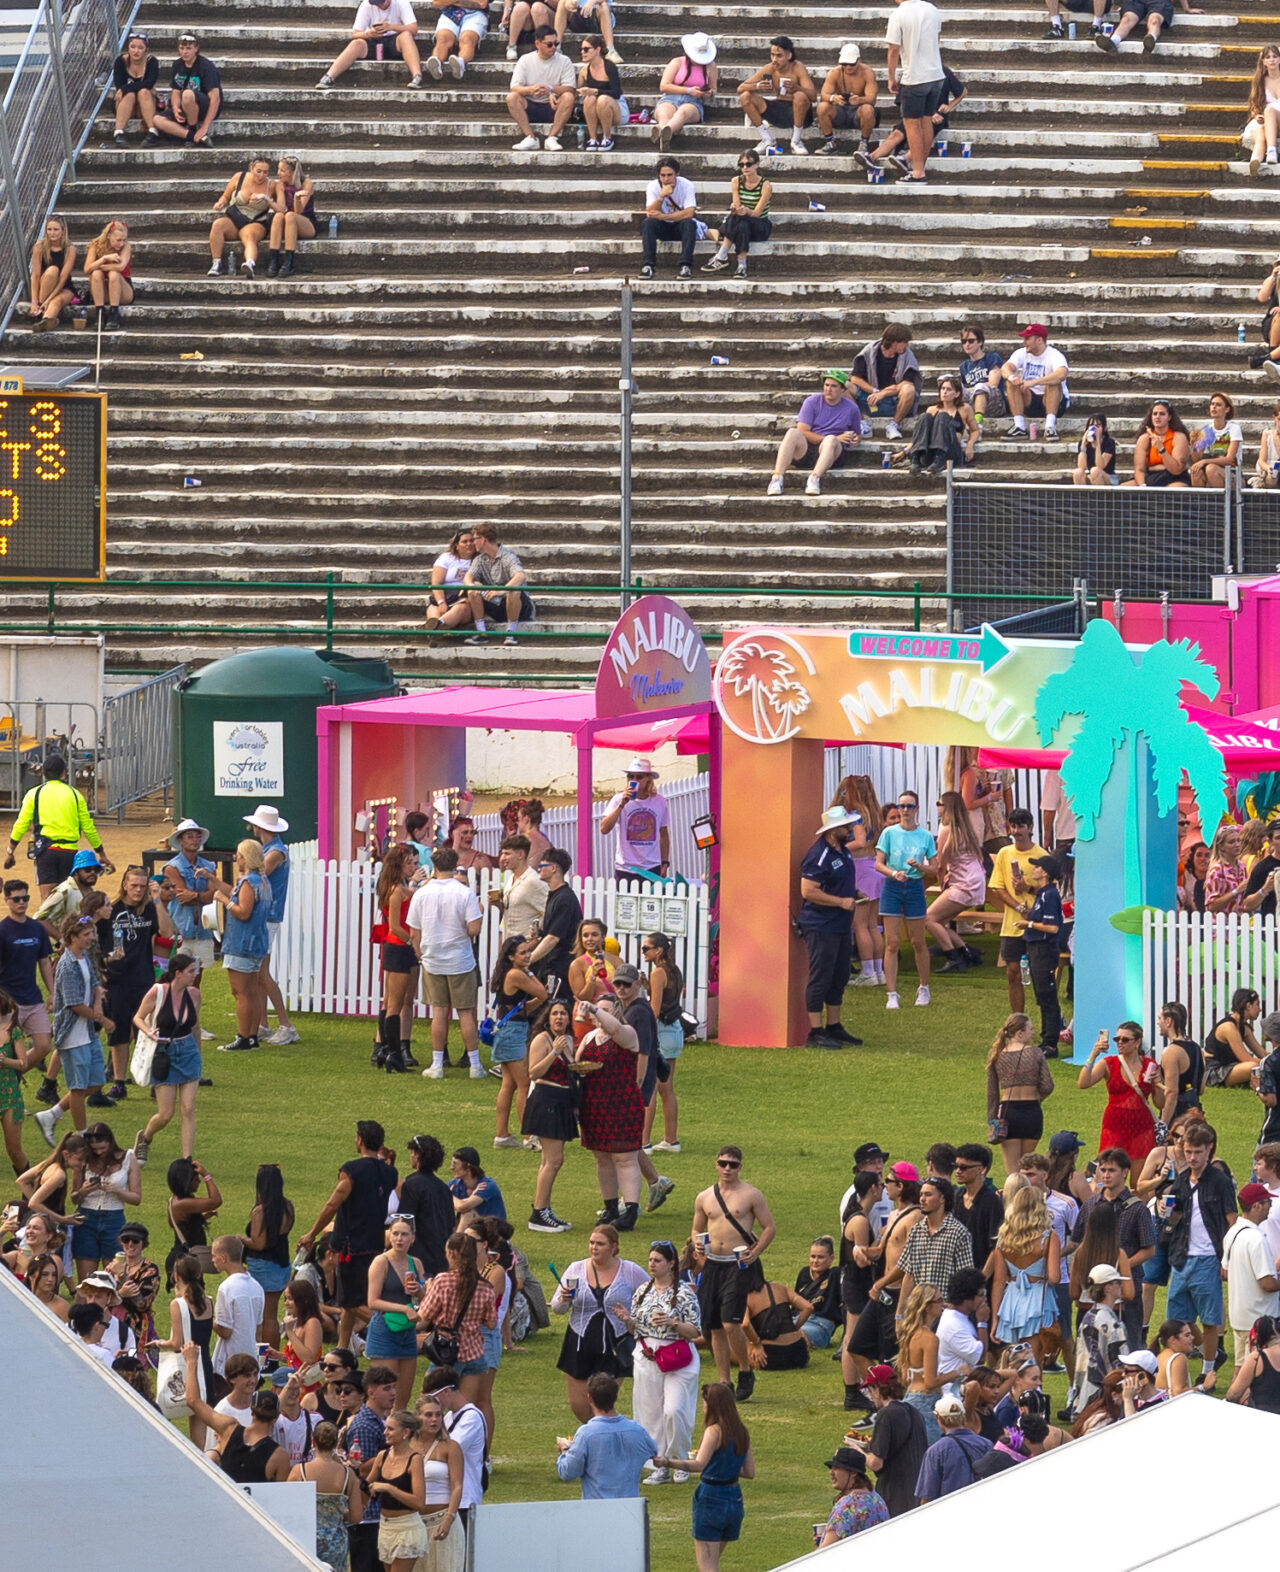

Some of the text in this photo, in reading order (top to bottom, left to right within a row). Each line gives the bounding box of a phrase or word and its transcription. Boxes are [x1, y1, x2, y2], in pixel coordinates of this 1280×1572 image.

[30, 402, 61, 439] 3
[609, 611, 702, 688] MALIBU
[860, 636, 980, 658] WELCOME TO
[628, 668, 685, 704] Makeover
[838, 667, 1028, 742] MALIBU
[227, 756, 267, 776] Free
[220, 777, 278, 792] Drinking Water
